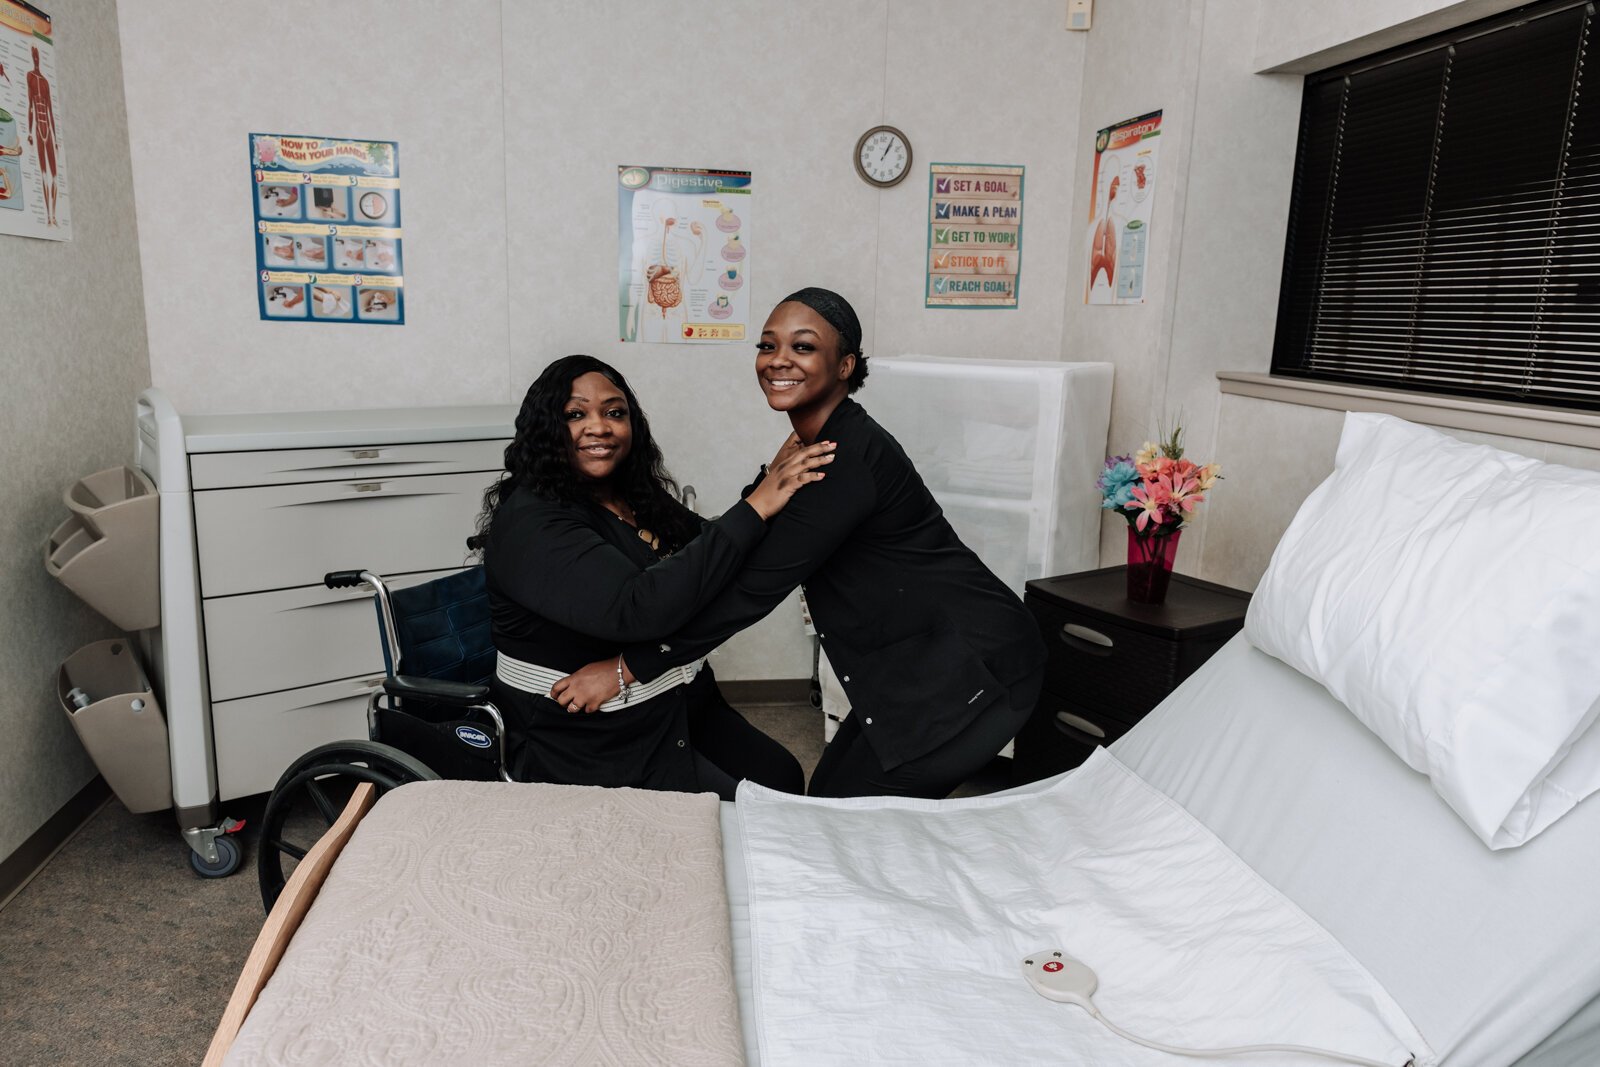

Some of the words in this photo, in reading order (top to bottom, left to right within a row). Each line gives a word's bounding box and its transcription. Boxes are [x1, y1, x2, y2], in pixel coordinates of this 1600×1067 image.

[1110, 121, 1156, 142] Respiratory
[281, 138, 304, 149] HOW
[305, 141, 318, 149] TO
[281, 149, 306, 160] WASH
[309, 148, 334, 160] YOUR
[336, 146, 367, 160] HANDS
[303, 172, 311, 184] 2
[349, 175, 358, 187] 3
[657, 174, 723, 188] Digestive
[953, 180, 972, 192] SET
[975, 180, 981, 192] A
[984, 181, 1008, 193] GOAL
[952, 205, 980, 217] MAKE
[983, 206, 989, 217] A
[992, 206, 1017, 218] PLAN
[328, 224, 337, 236] 5
[951, 231, 970, 242] GET
[973, 231, 985, 243] TO
[989, 232, 1016, 243] WORK
[950, 256, 978, 267] STICK
[982, 256, 993, 268] TO
[996, 256, 1006, 268] IT
[261, 270, 270, 282] 6
[308, 272, 317, 284] 7
[354, 274, 362, 286] 8
[949, 281, 981, 292] REACH
[983, 281, 1011, 293] GOAL!
